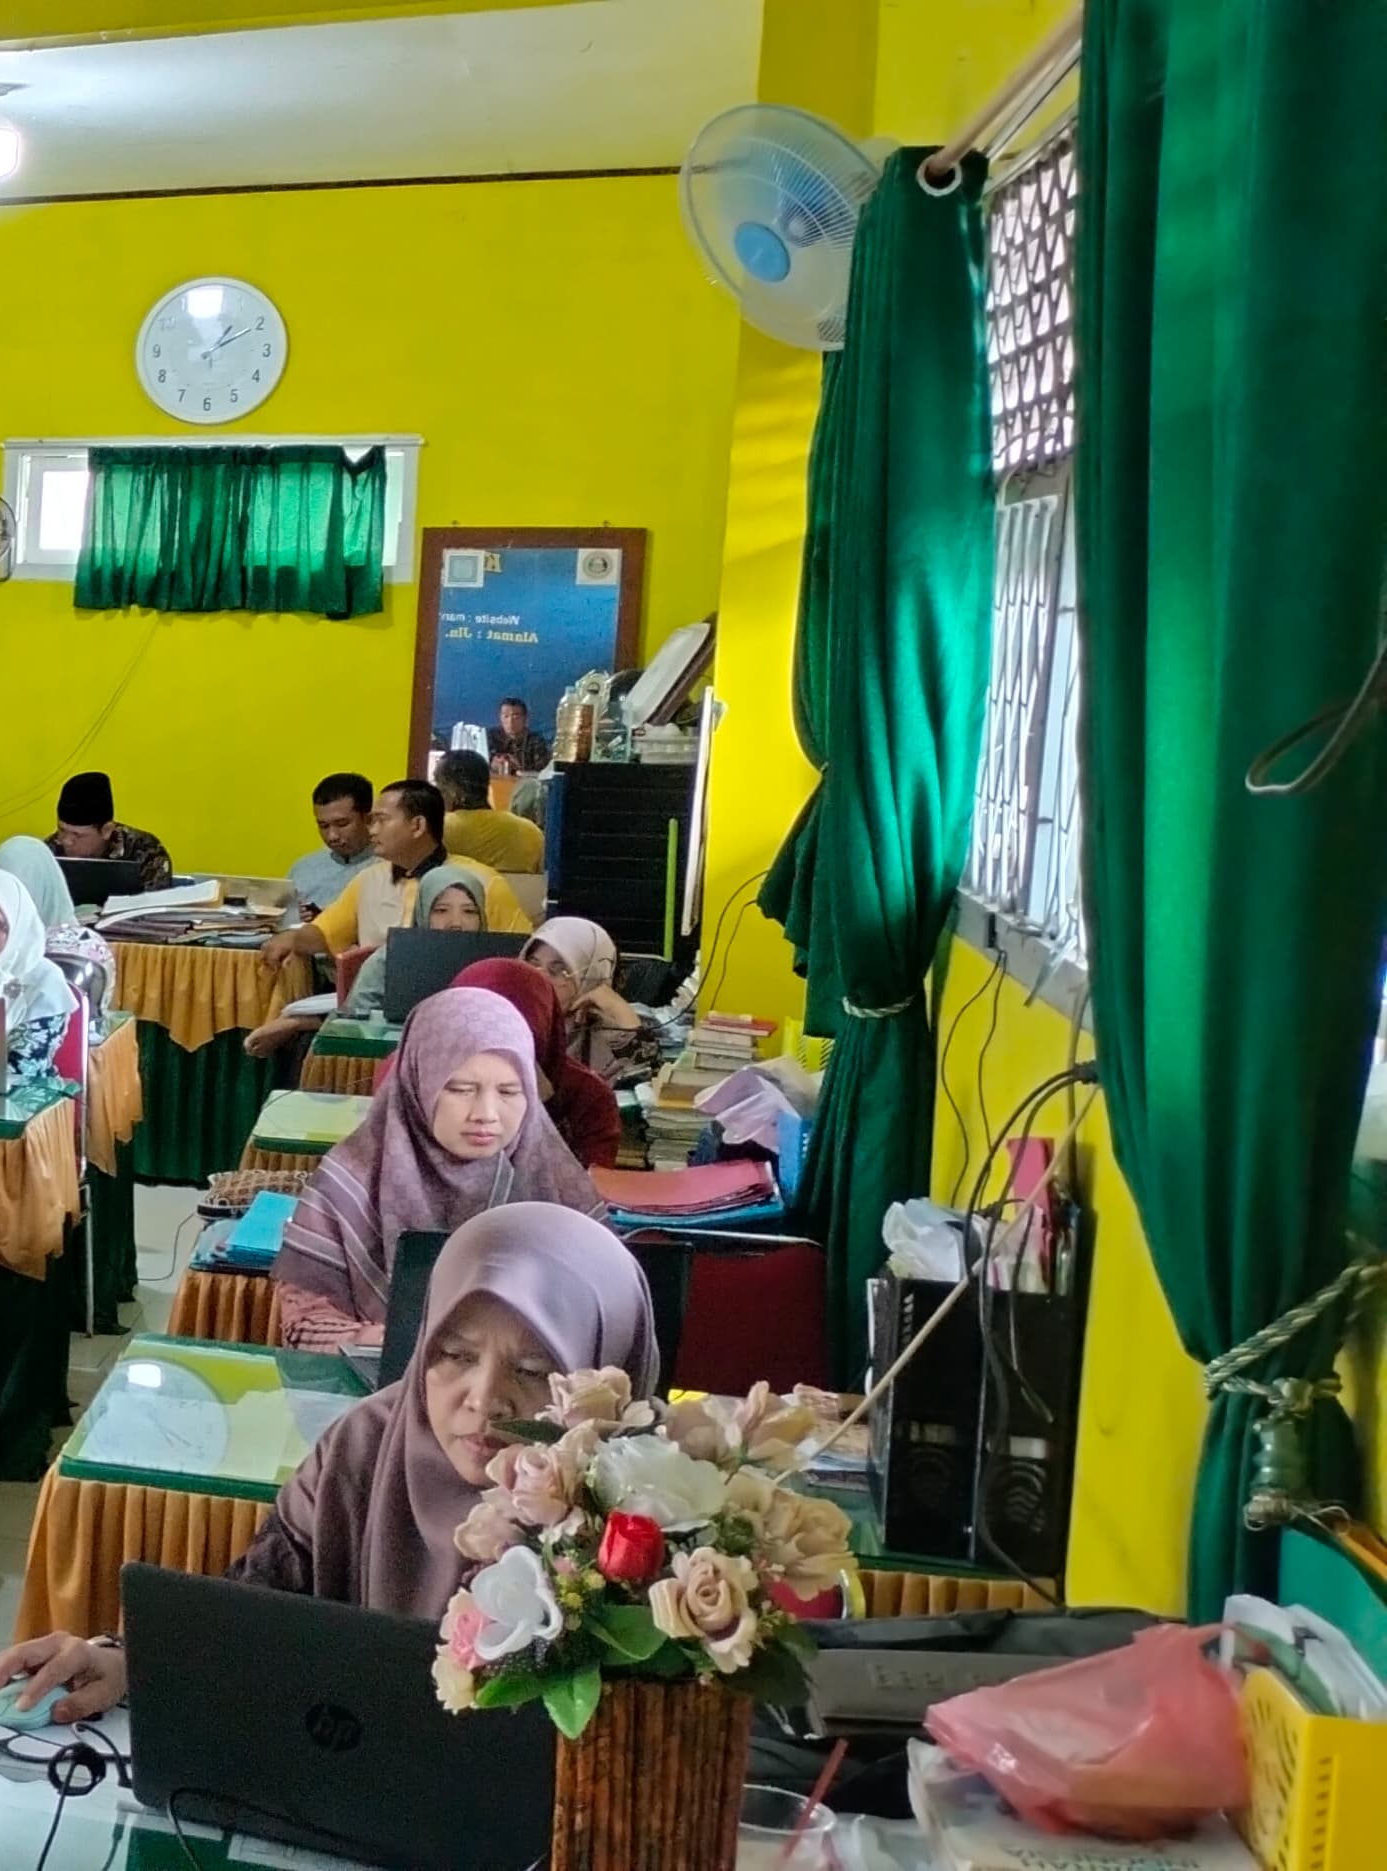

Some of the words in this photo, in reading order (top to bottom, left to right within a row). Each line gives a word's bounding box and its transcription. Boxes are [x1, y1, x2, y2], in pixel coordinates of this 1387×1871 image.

[255, 316, 265, 331] 2
[153, 344, 161, 358] 9
[262, 343, 271, 358] 3
[158, 369, 166, 383] 8
[251, 369, 260, 383] 4
[178, 389, 186, 403] 7
[230, 389, 239, 403] 5
[203, 397, 211, 412] 6
